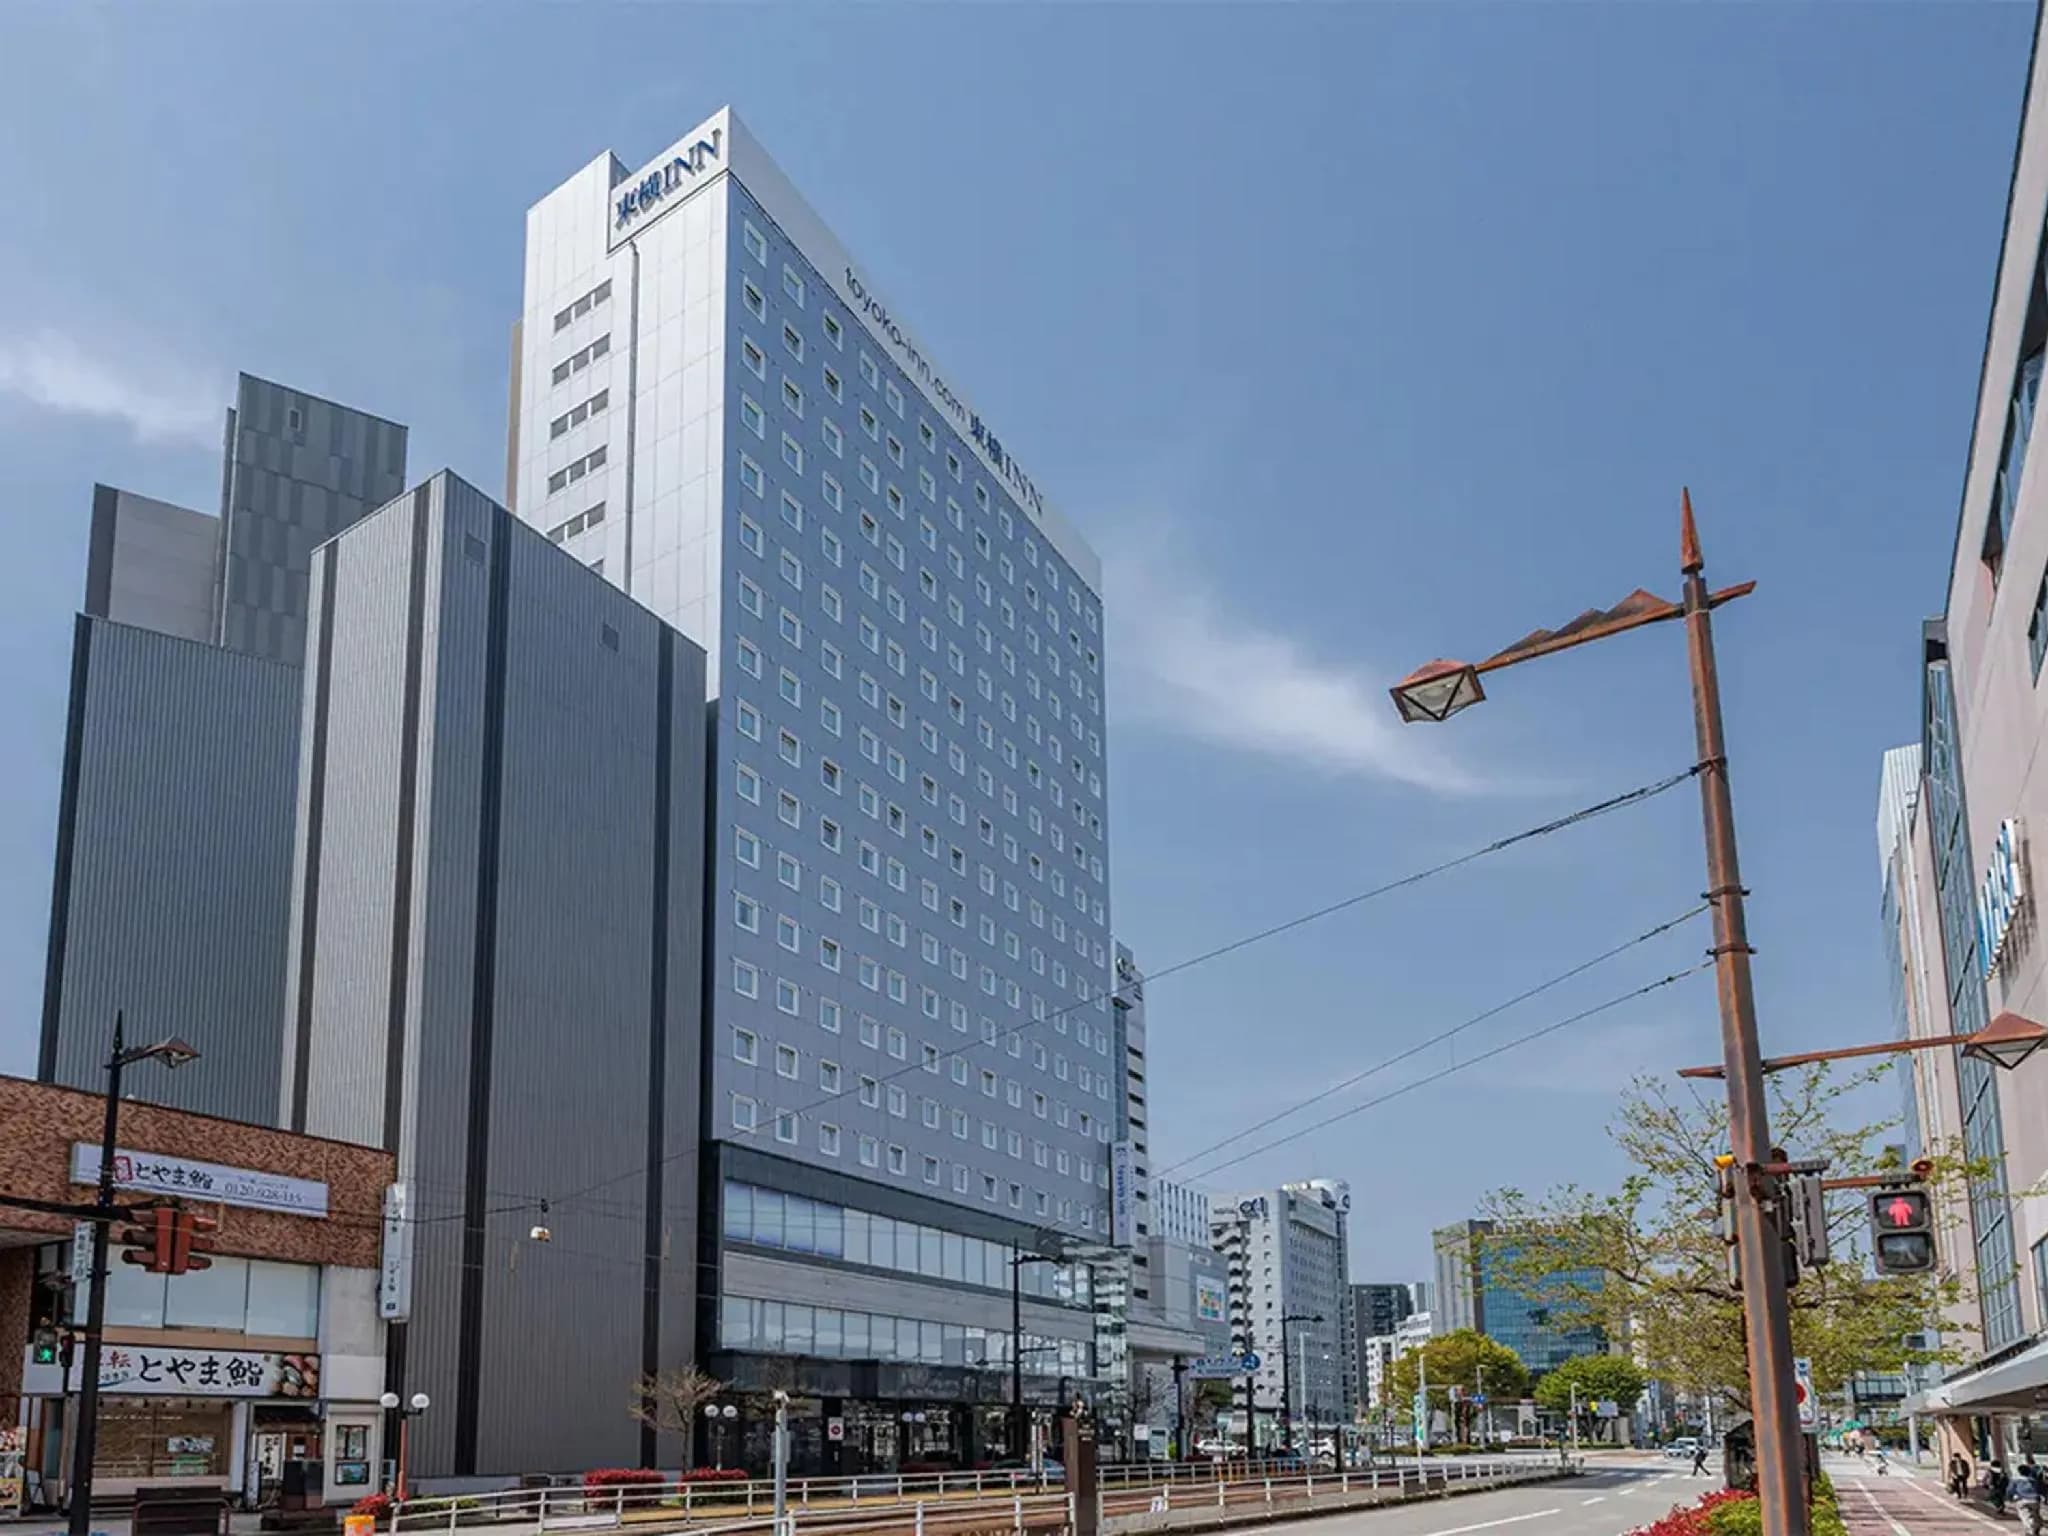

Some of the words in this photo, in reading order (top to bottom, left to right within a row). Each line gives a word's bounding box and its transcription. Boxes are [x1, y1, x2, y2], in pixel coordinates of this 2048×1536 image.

[845, 266, 966, 423] toyoko-inn.com
[140, 1354, 264, 1388] とやま鮨
